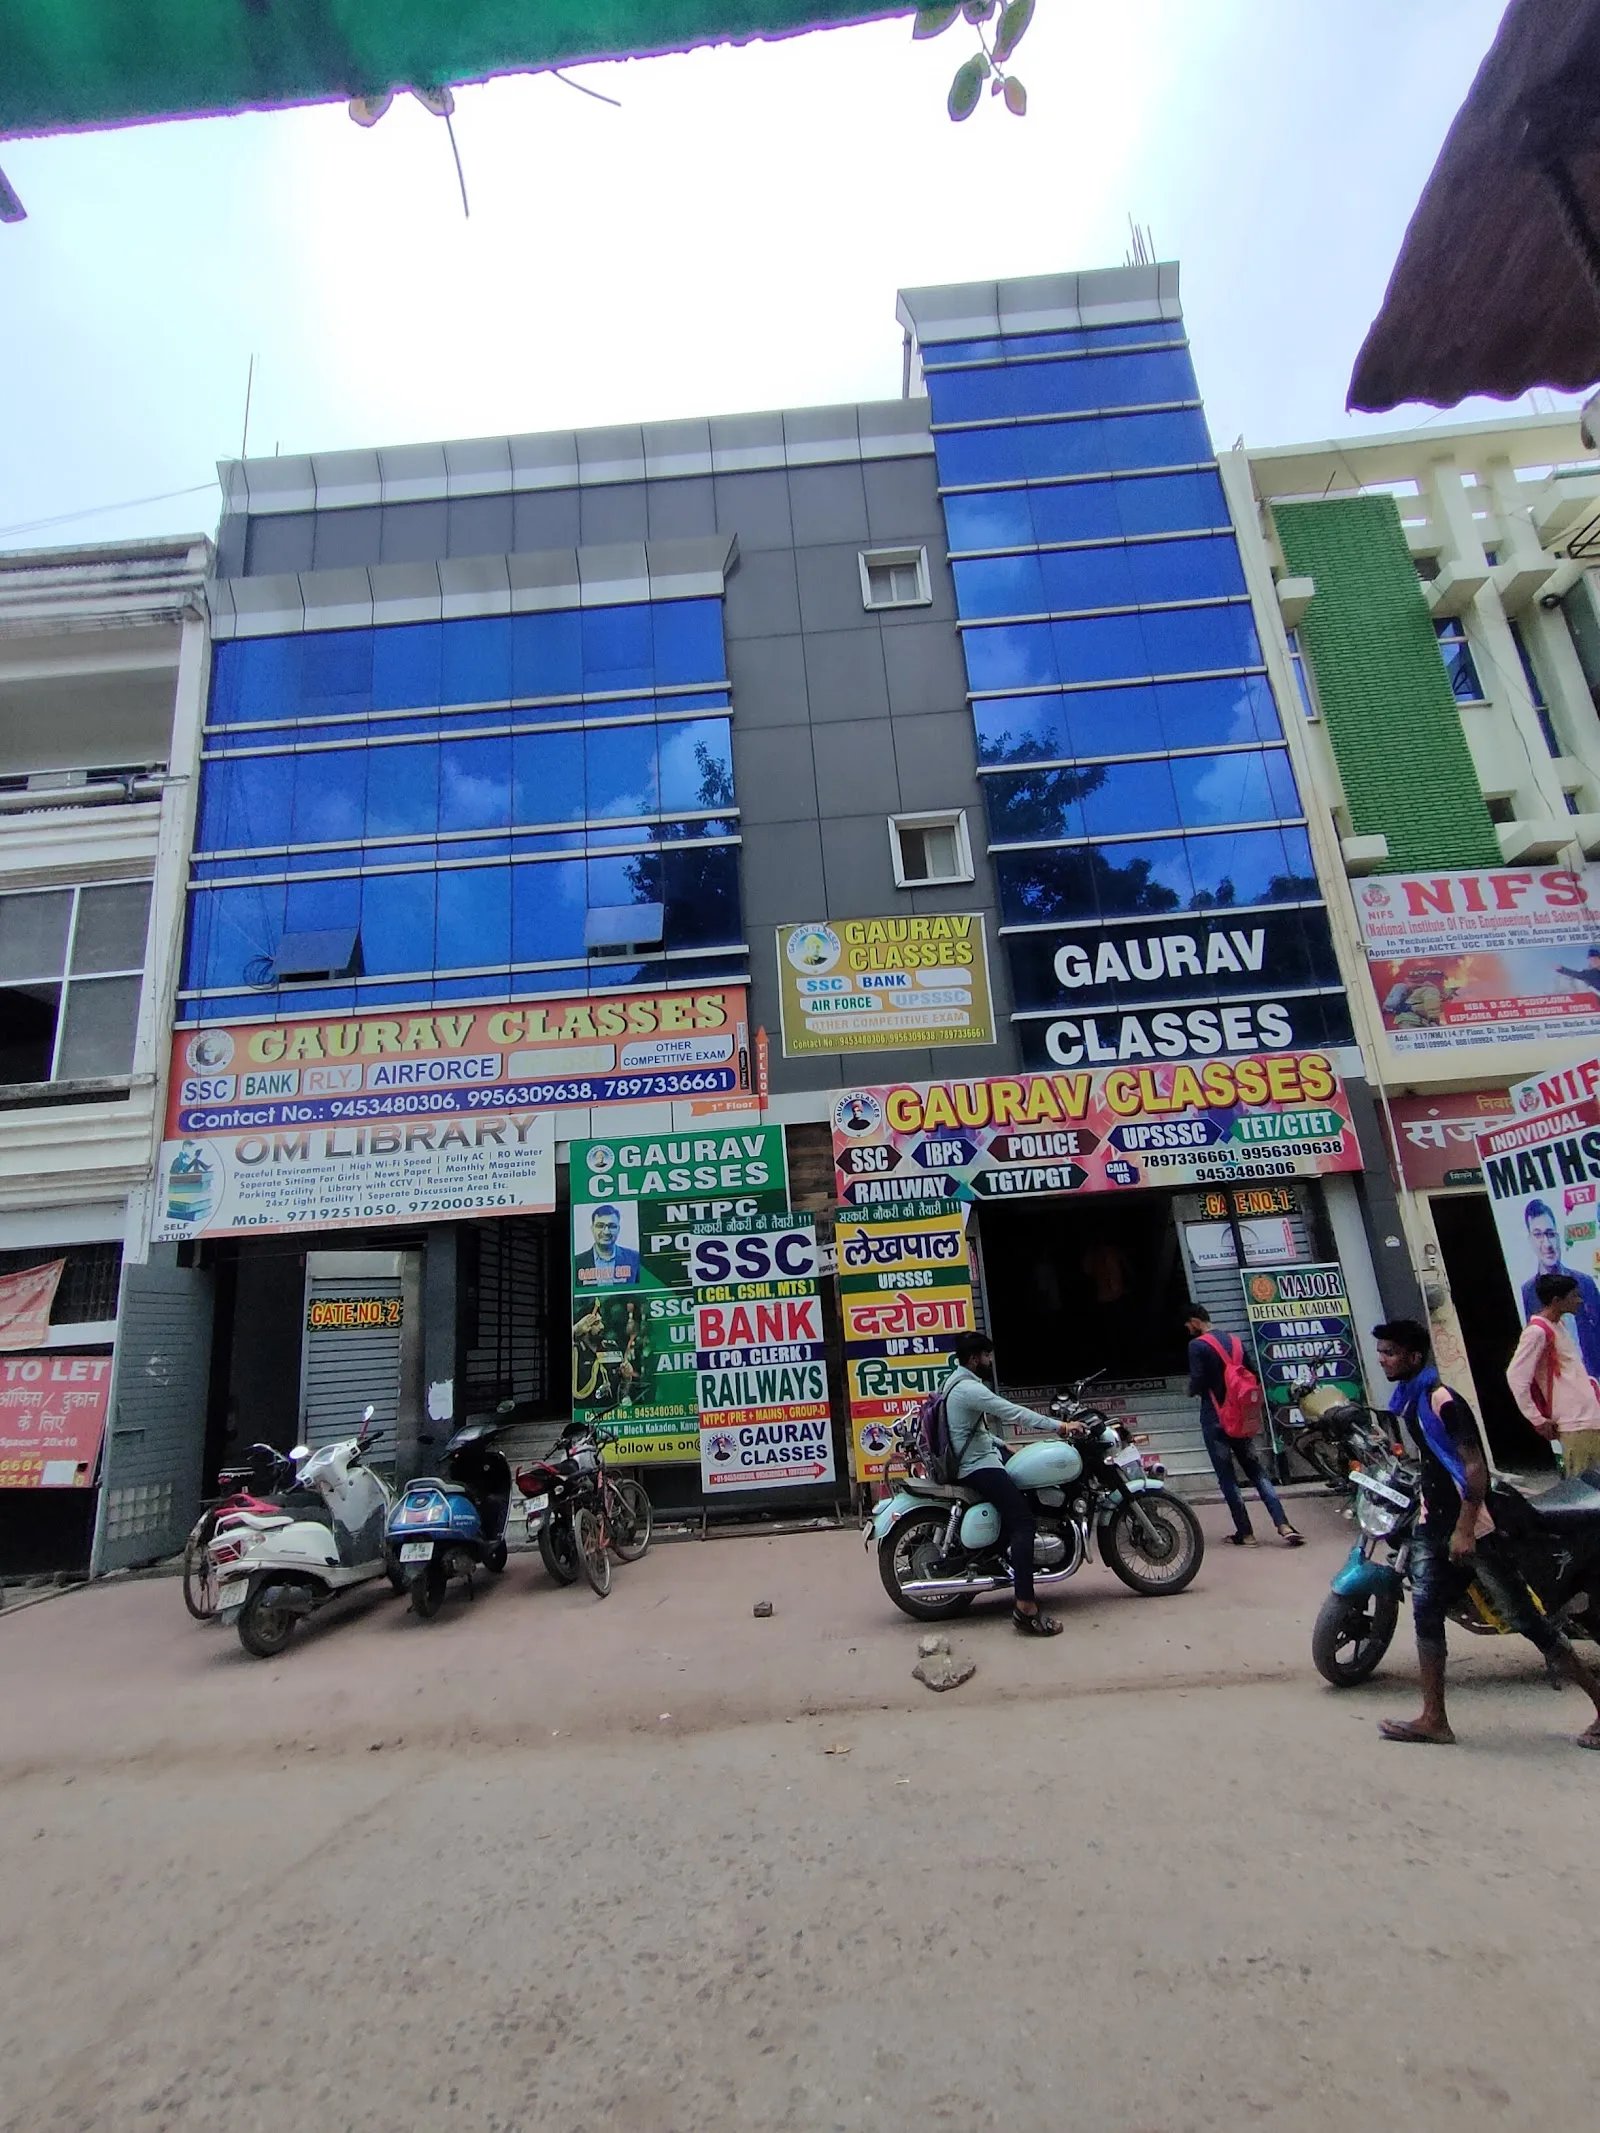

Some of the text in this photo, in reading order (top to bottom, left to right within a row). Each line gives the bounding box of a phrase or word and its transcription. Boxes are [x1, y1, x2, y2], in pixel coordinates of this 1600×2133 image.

[1401, 870, 1589, 917] NIFS
[1368, 911, 1394, 919] NIFS
[845, 917, 972, 945] GAURAV
[849, 941, 974, 971] CLASSES
[1054, 929, 1265, 989] GAURAV
[806, 974, 907, 992] SSC BANK
[812, 990, 966, 1012] AIR FORCE UPSSSC
[248, 994, 728, 1063] GAURAV CLASSES
[812, 1012, 964, 1031] OTHER COMPETITIVE EXAM
[793, 1039, 821, 1050] Contact
[1045, 1003, 1293, 1066] CLASSES
[623, 1050, 726, 1066] COMPETITIVE EXAM
[656, 1042, 692, 1052] OTHER
[184, 1057, 495, 1100] SSC BANK RLY. AIRFORCE
[188, 1072, 728, 1130] Contact No.: 9453480306, 9956309638, 7897336661
[726, 1100, 753, 1110] Floor
[885, 1054, 1337, 1134] GAURAV CLASSES
[235, 1114, 540, 1167] OM LIBRARY
[851, 1111, 1332, 1173] SSC IBPS POLICE UPSSSC TET/CTET
[1489, 1111, 1587, 1154] INDIVIDUAL
[619, 1134, 765, 1168] GAURAV
[233, 1169, 273, 1179] Peaceful
[276, 1165, 336, 1176] Environment
[350, 1161, 372, 1171] High
[375, 1158, 400, 1167] Wi-Fi
[404, 1157, 431, 1167] Speed
[446, 1154, 468, 1163] Fully
[240, 1179, 282, 1189] Seperate
[285, 1177, 316, 1186] Sitting
[338, 1173, 360, 1182] Girls
[374, 1171, 400, 1179] News
[404, 1168, 431, 1177] Paper
[446, 1163, 485, 1173] Monthly
[489, 1159, 536, 1169] Magazine
[855, 1140, 1343, 1204] RAILWAY TGT/PGT CALL 7897336661, 9956309638
[1117, 1162, 1296, 1184] US 9453480306
[1486, 1131, 1600, 1201] MATHS
[239, 1170, 537, 1199] Parking Facility Library with CCTV Reserve Seat Available
[587, 1162, 769, 1198] CLASSES
[266, 1199, 290, 1207] 24x7
[293, 1197, 316, 1206] Light
[320, 1194, 354, 1203] Facility
[368, 1191, 410, 1200] Seperate
[414, 1186, 463, 1196] Discussion
[467, 1183, 489, 1191] Area
[1206, 1193, 1246, 1216] GAE
[1278, 1189, 1289, 1210] 1
[287, 1203, 402, 1222] 9719251050,
[409, 1194, 524, 1212] 9720003561,
[666, 1199, 758, 1223] NTPC
[838, 1200, 960, 1224] सरकारी नौकरी की तैयारी !!!
[163, 1223, 189, 1231] SELF
[692, 1214, 812, 1235] सरकारी नौकरी की तैयारी !!!
[158, 1232, 193, 1242] STUDY
[843, 1229, 960, 1266] लेखपाल
[695, 1234, 814, 1283] SSC
[706, 1280, 806, 1302] CGL, CSHL, MTS
[878, 1270, 934, 1290] UPSSSC
[1276, 1272, 1343, 1300] MAJOR
[311, 1302, 399, 1325] GATE NO. 2
[850, 1293, 967, 1334] दरोगा
[1252, 1300, 1345, 1320] DEFENCE ACADEMY
[699, 1300, 817, 1348] BANK
[1279, 1321, 1326, 1337] NDA
[719, 1345, 803, 1368] PO, CLERK
[886, 1336, 940, 1356] UP S.I.
[4, 1360, 110, 1381] TO LET
[701, 1366, 824, 1408] RAILWAYS
[635, 1405, 686, 1418] 9453480306,
[703, 1413, 726, 1425] NTPC
[728, 1411, 746, 1426] (PRE
[756, 1407, 788, 1423] MAINS),
[789, 1405, 826, 1417] GROUP-D
[883, 1402, 900, 1414] UP,
[18, 1410, 66, 1433] के लिए
[739, 1422, 825, 1446] GAURAV
[615, 1442, 673, 1454] follow us
[741, 1445, 828, 1466] CLASSES
